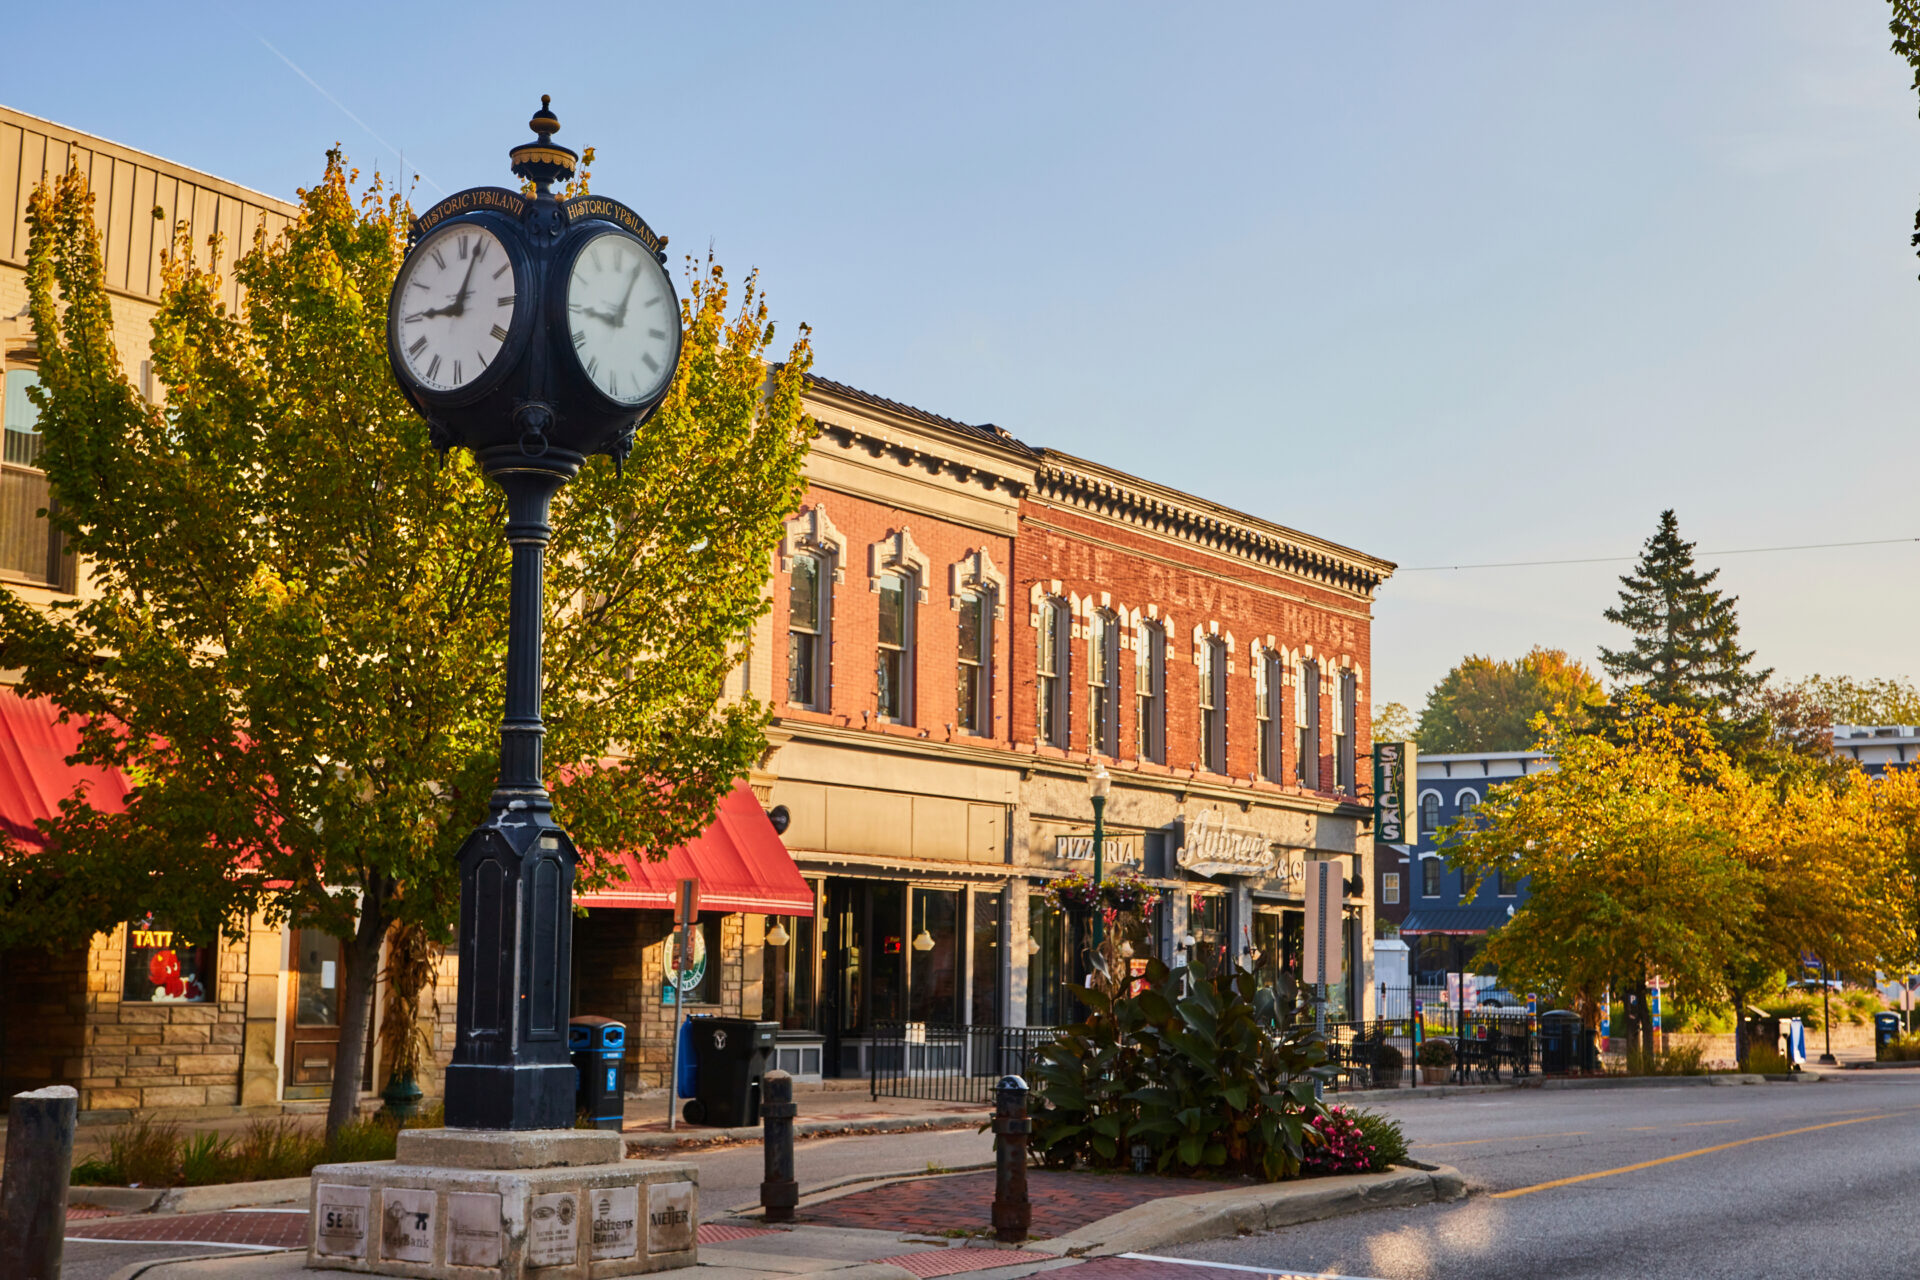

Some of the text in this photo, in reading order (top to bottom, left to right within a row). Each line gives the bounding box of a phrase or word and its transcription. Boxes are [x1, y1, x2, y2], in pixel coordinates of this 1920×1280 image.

[419, 191, 524, 232] HISTORIC YPSILANTI
[567, 200, 660, 253] HISTORIC YPSILANTI
[1378, 745, 1401, 840] STICKS
[1176, 808, 1276, 868] Aubree's
[1276, 858, 1290, 879] &
[669, 970, 702, 990] CANABIS
[593, 1218, 634, 1231] Citizens
[593, 1231, 620, 1244] Bank
